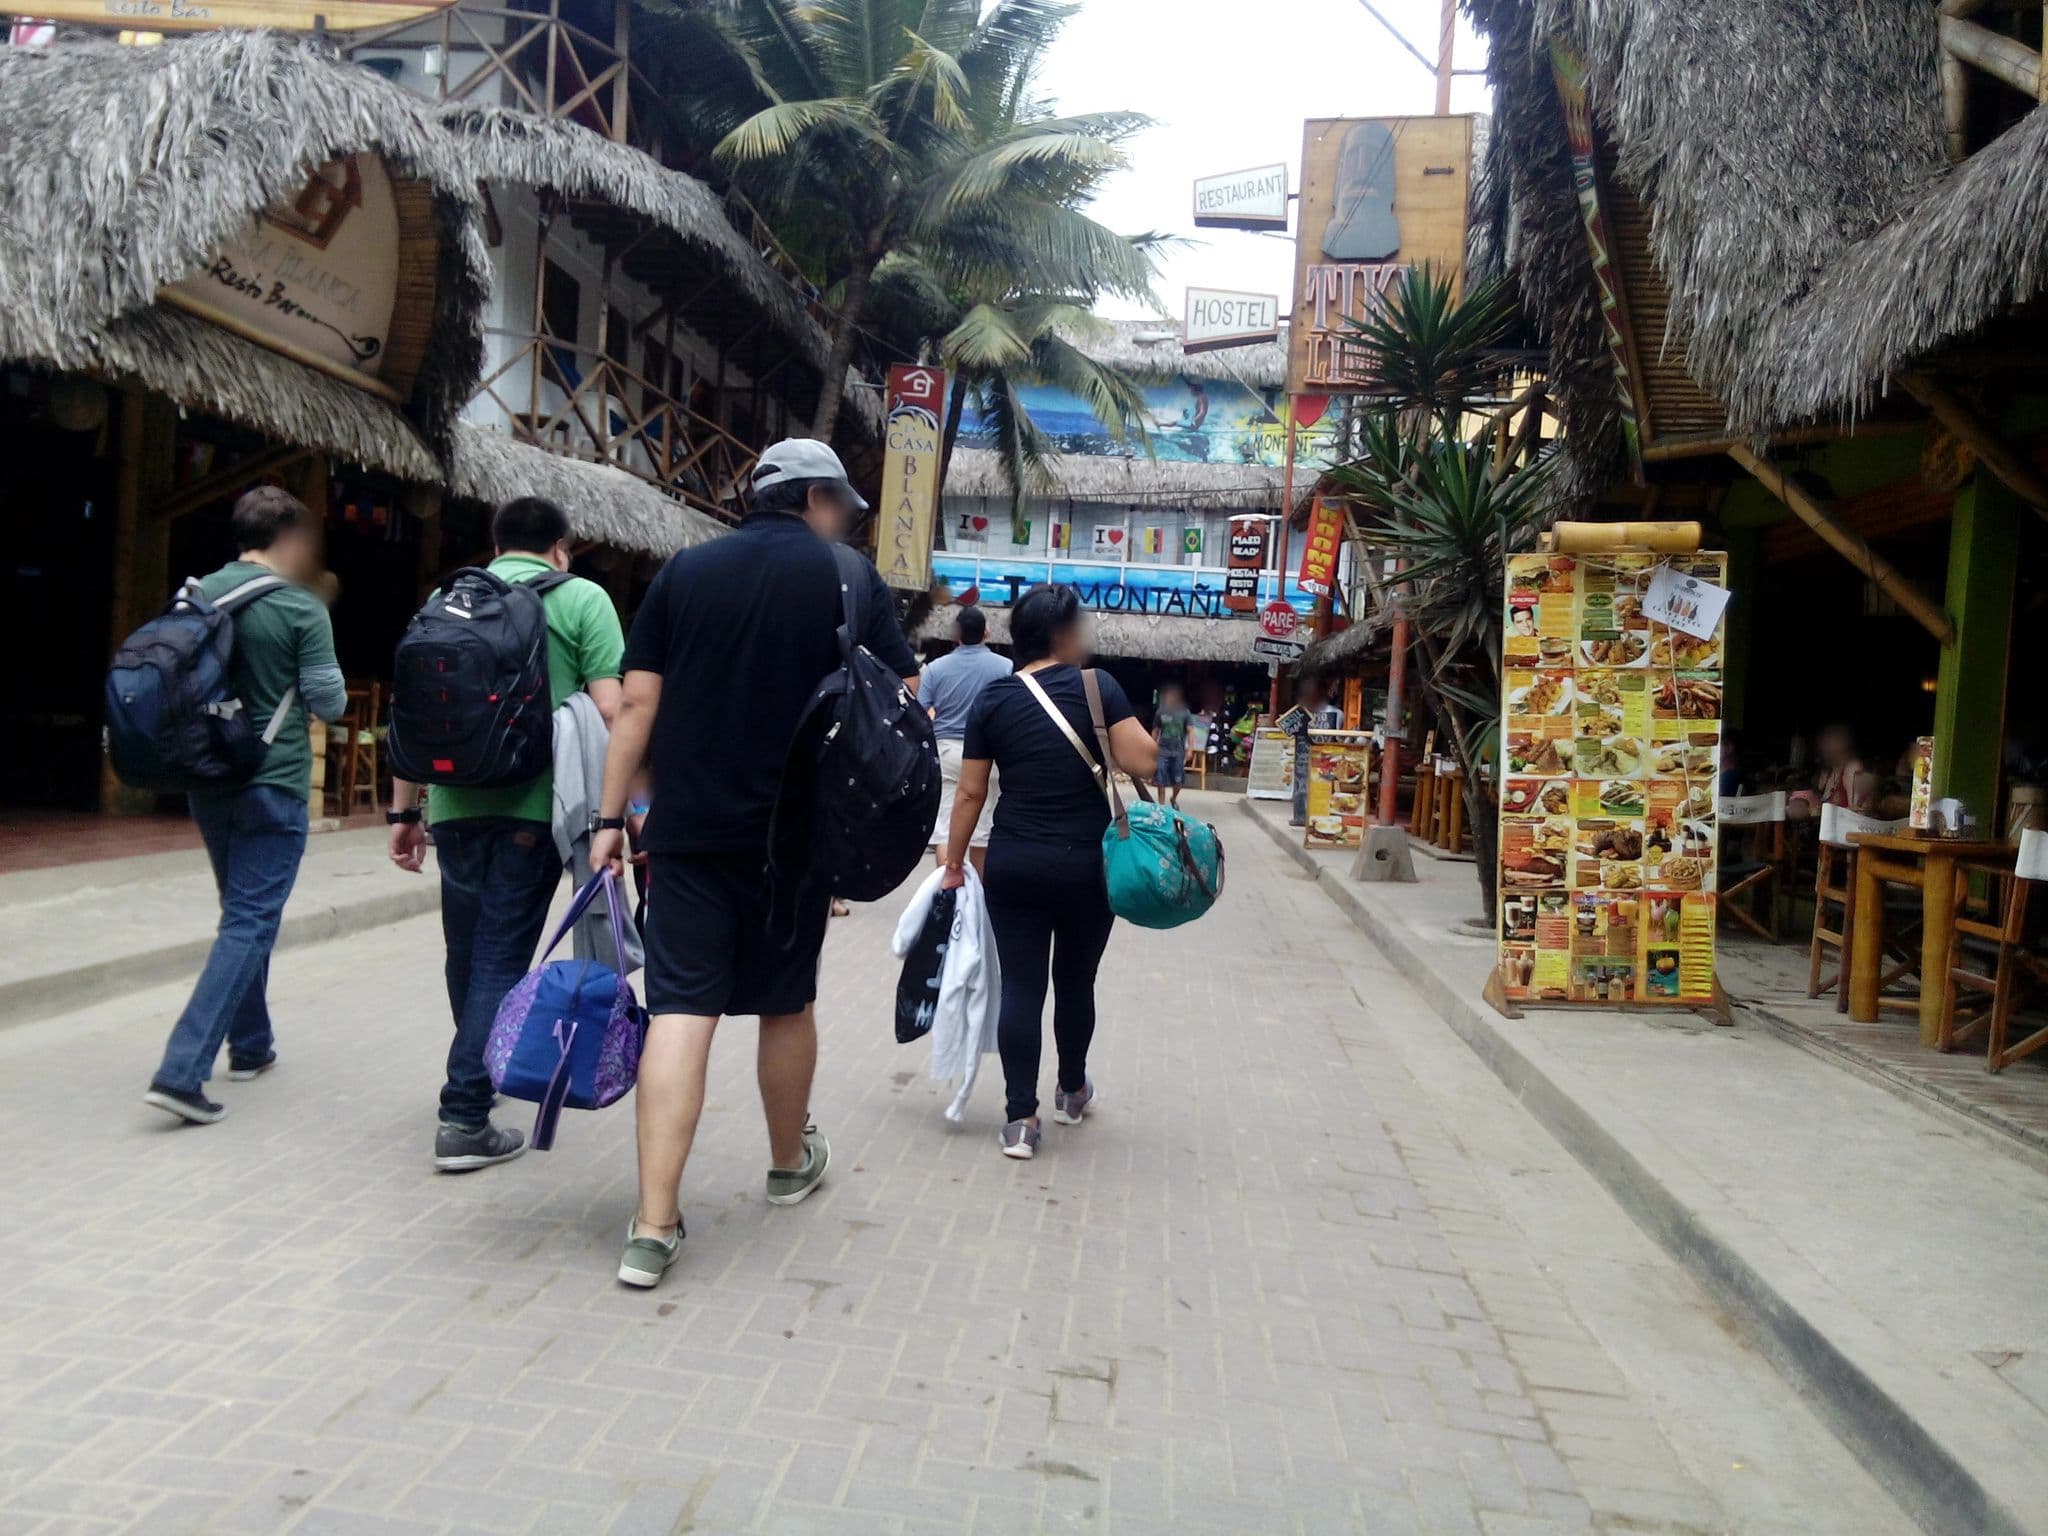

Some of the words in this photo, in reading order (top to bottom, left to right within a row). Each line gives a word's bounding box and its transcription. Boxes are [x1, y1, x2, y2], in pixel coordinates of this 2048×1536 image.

[1199, 174, 1283, 211] RESTAURANT
[1193, 299, 1271, 328] HOSTEL
[888, 431, 934, 453] CASA
[894, 454, 917, 569] BLANCA
[1306, 507, 1338, 579] ROOMS
[1072, 581, 1228, 617] MONTAÑI
[1263, 611, 1295, 628] PARE
